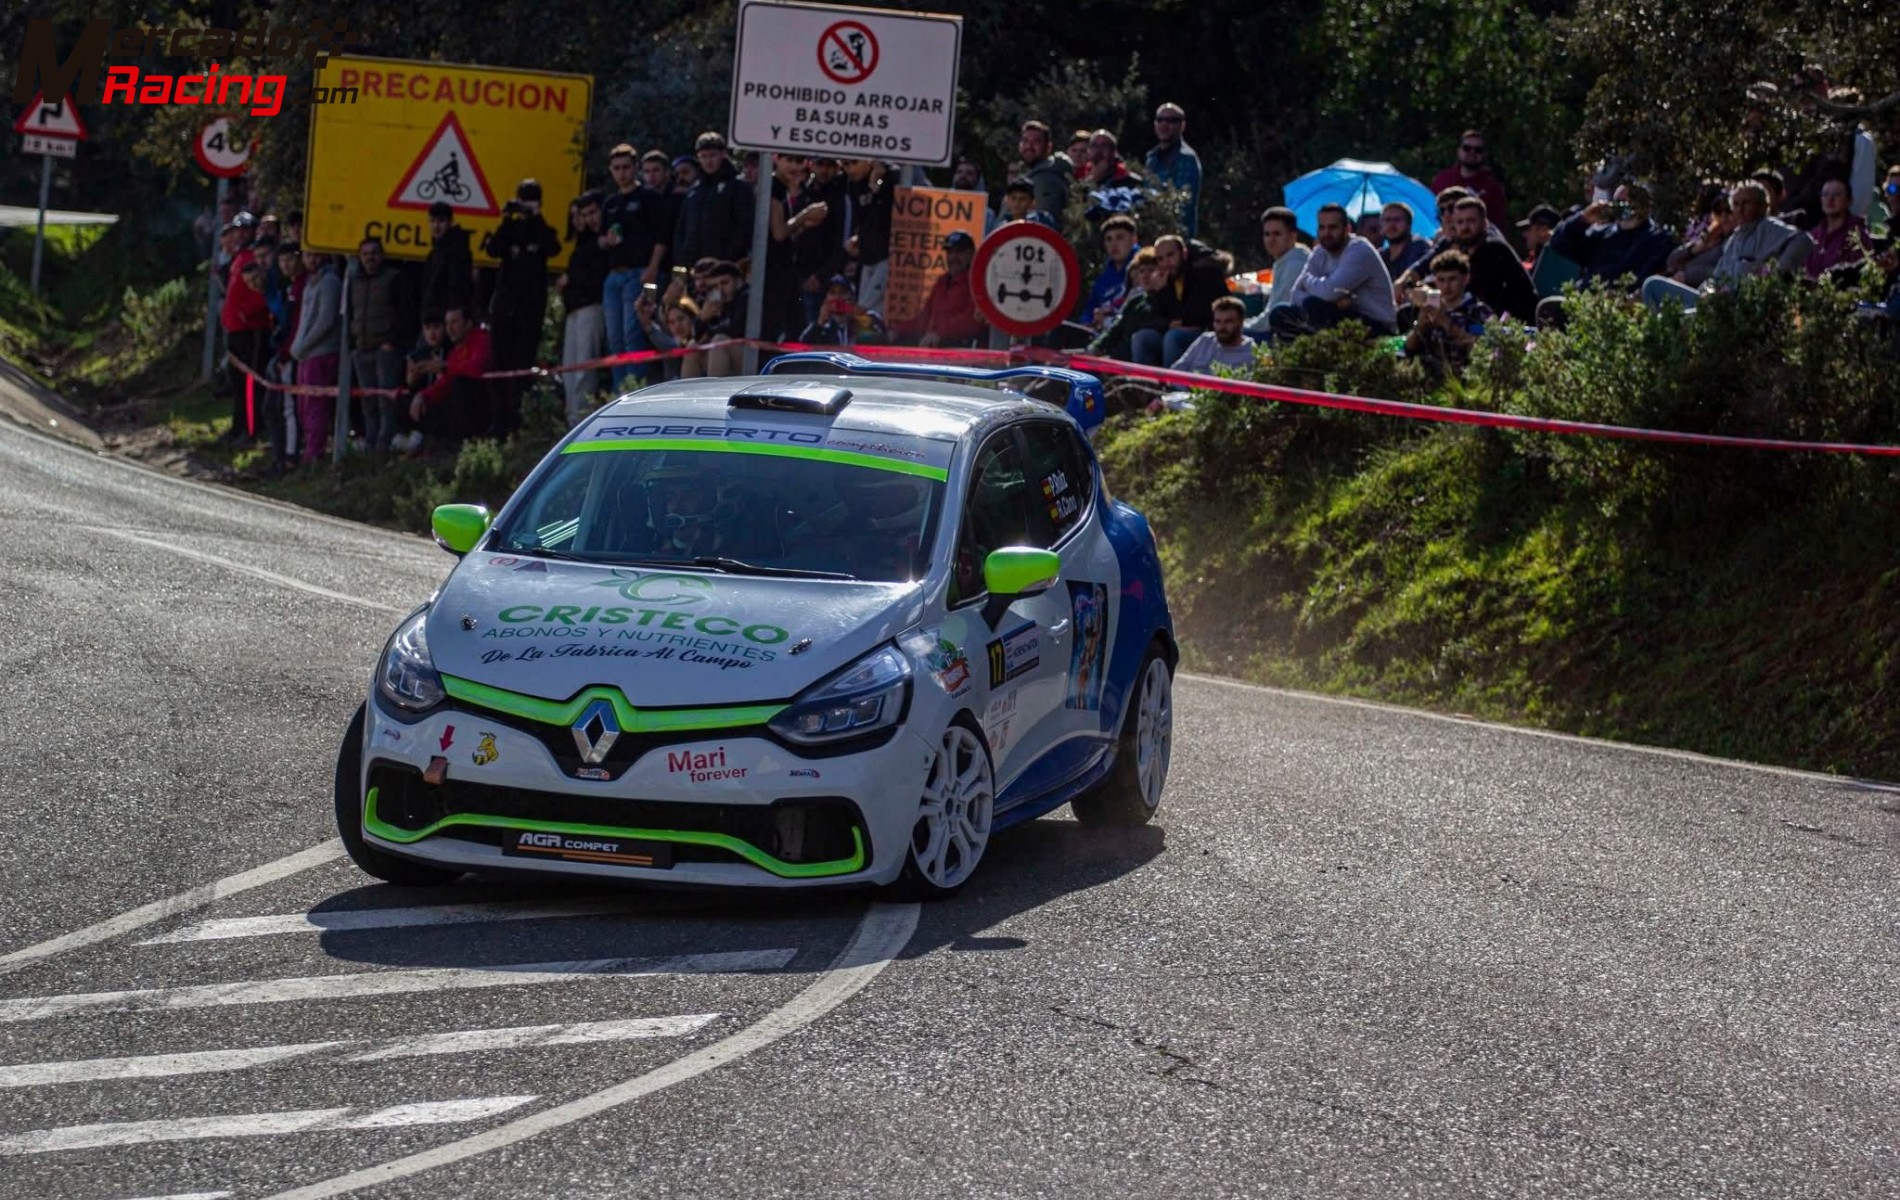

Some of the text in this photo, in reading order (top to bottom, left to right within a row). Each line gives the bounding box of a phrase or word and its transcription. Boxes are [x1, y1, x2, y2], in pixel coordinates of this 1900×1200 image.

[340, 68, 569, 113] PRECAUCION
[743, 82, 944, 114] PROHIBIDO ARROJAR
[796, 108, 890, 130] BASURAS
[770, 126, 912, 151] Y ESCOMBROS
[893, 194, 974, 223] NCIÓN
[894, 231, 947, 250] ETER
[893, 250, 948, 271] TADA
[1014, 245, 1046, 264] 10t
[595, 425, 822, 444] ROBERTO
[497, 605, 790, 645] CRISTECO
[482, 626, 777, 662] ABONOS Y NUTRIENTES
[481, 643, 755, 671] De La Fabrica Al Campo
[667, 746, 727, 773] Mari
[689, 767, 748, 784] forever
[519, 832, 620, 853] AGR COMPET
